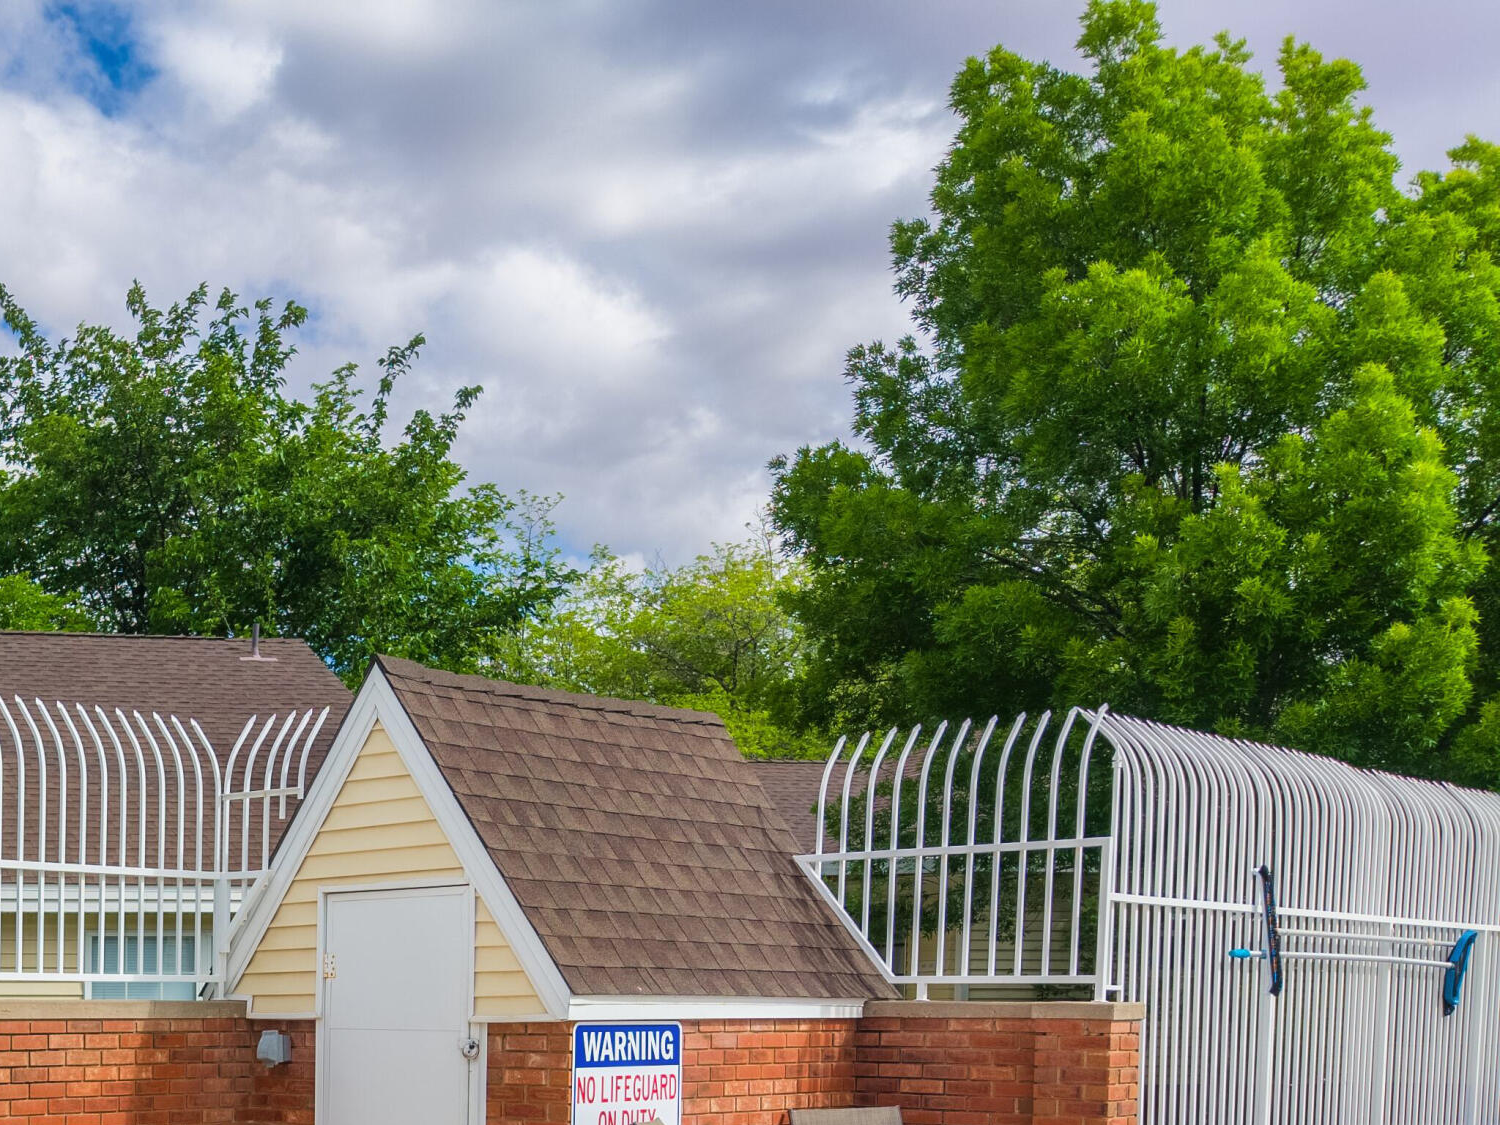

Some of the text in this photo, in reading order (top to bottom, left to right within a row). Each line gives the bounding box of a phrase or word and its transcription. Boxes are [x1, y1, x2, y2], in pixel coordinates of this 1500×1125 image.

[583, 1031, 673, 1062] WARNING
[577, 1074, 677, 1104] NO LIFEGUARD
